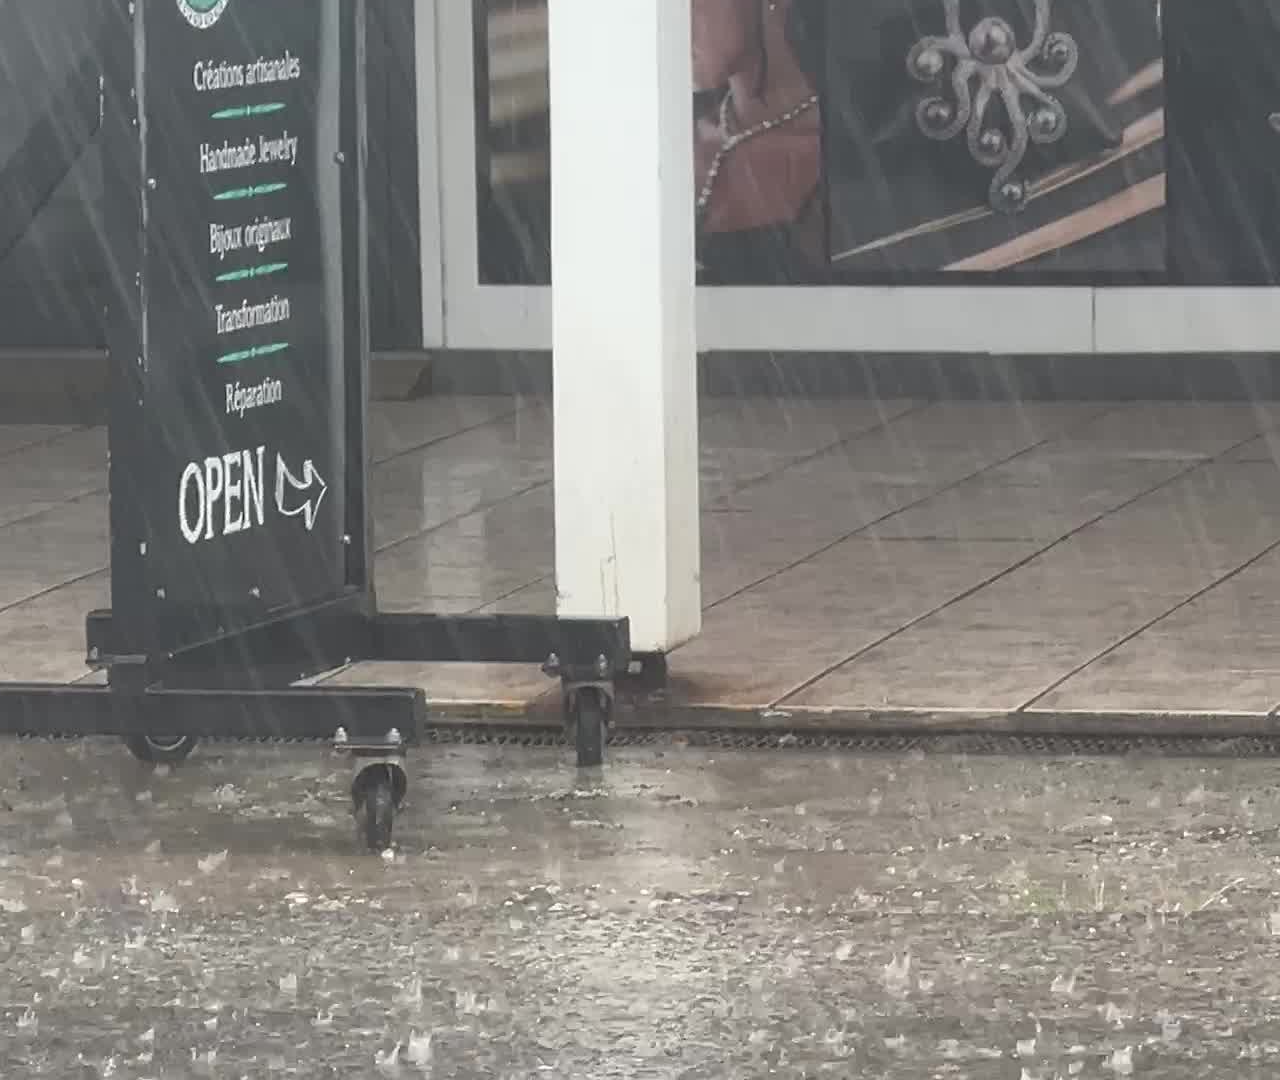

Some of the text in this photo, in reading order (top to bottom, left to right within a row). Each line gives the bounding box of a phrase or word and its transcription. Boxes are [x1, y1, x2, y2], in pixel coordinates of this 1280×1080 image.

[193, 50, 300, 91] Créations artisanales
[200, 130, 298, 173] Handmade Jewelry
[209, 216, 291, 261] Bijoux originaux
[215, 294, 290, 334] Transformation
[225, 377, 282, 418] Réparation
[179, 445, 265, 543] OPEN
